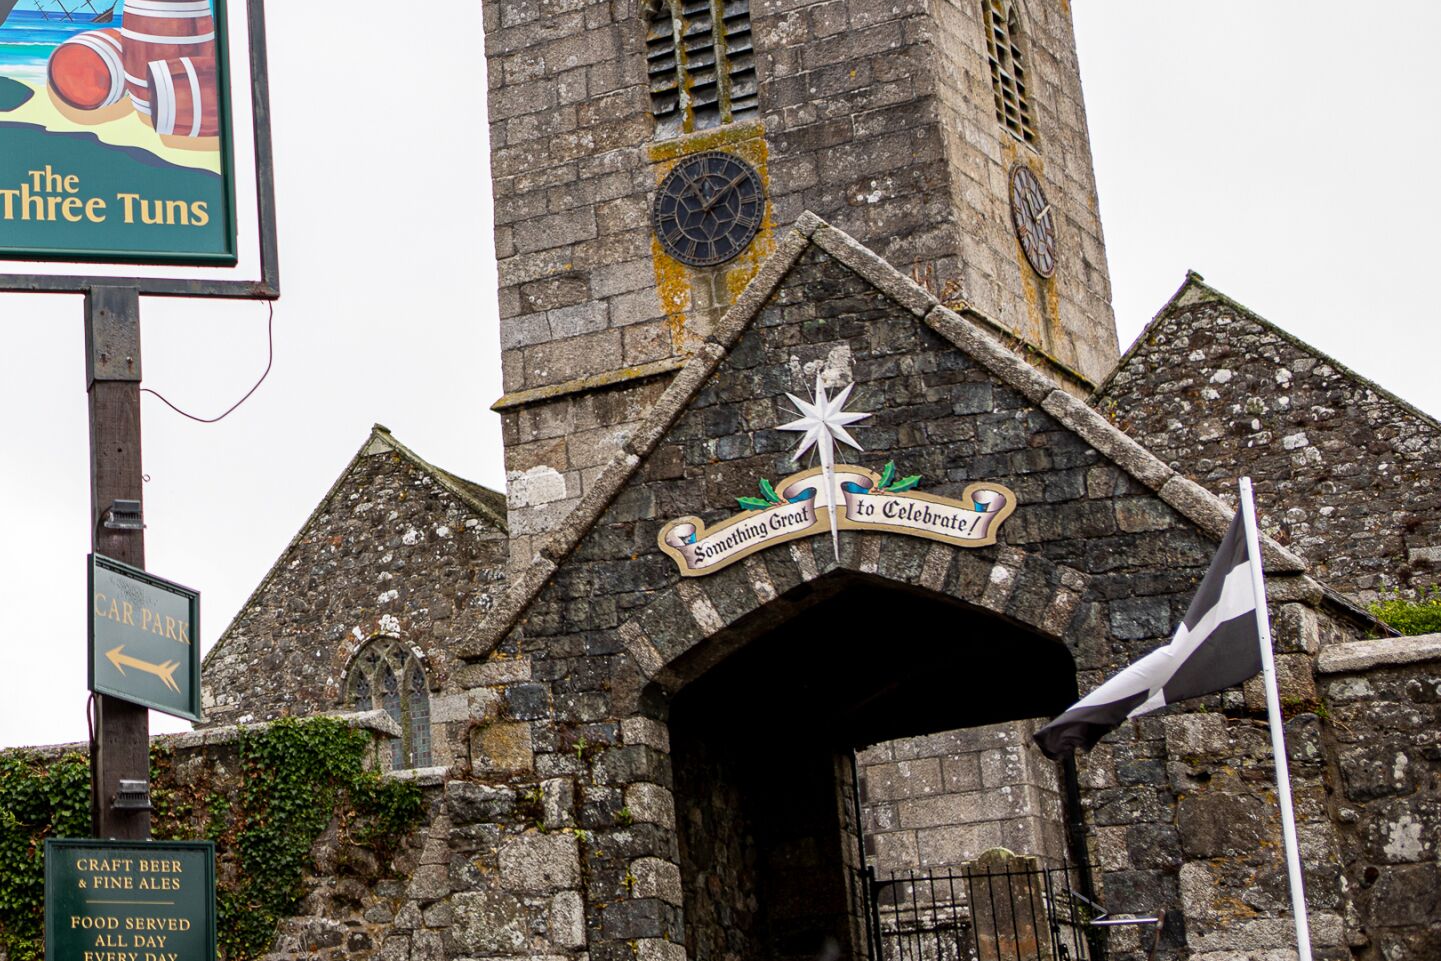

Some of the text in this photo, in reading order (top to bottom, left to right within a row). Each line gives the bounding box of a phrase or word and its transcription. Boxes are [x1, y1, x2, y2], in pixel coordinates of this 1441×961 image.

[28, 165, 79, 193] The
[117, 193, 209, 227] Tuns
[694, 500, 982, 565] Something Great to Celebrate!
[94, 592, 192, 646] CAR PARK
[76, 858, 183, 873] CRAFT BEER
[78, 876, 181, 890] & FINE ALES
[70, 916, 192, 932] FOOD SERVED
[95, 934, 167, 949] ALL DAY
